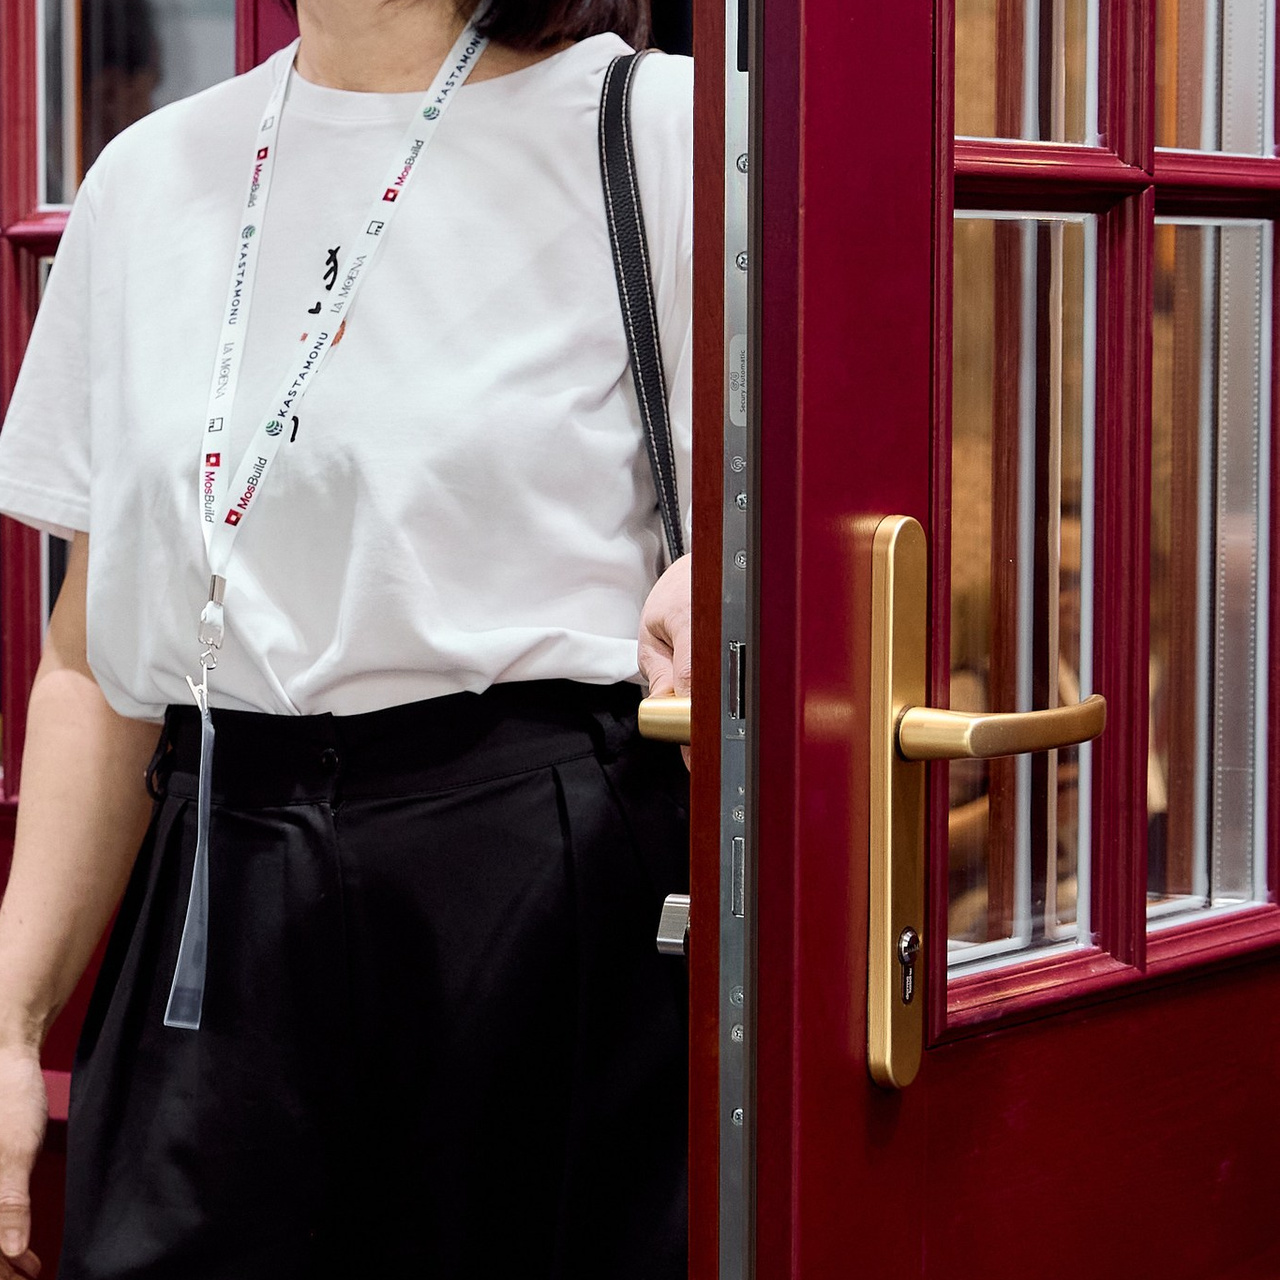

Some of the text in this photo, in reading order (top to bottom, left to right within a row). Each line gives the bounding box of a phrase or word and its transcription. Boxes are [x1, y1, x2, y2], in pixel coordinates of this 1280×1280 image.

[247, 163, 263, 208] MosBuild
[394, 139, 424, 186] MosBuild
[228, 243, 249, 326] KASTAMONU
[277, 332, 328, 418] KASTAMONU
[204, 471, 215, 523] MosBuild
[237, 456, 268, 510] MosBuild
